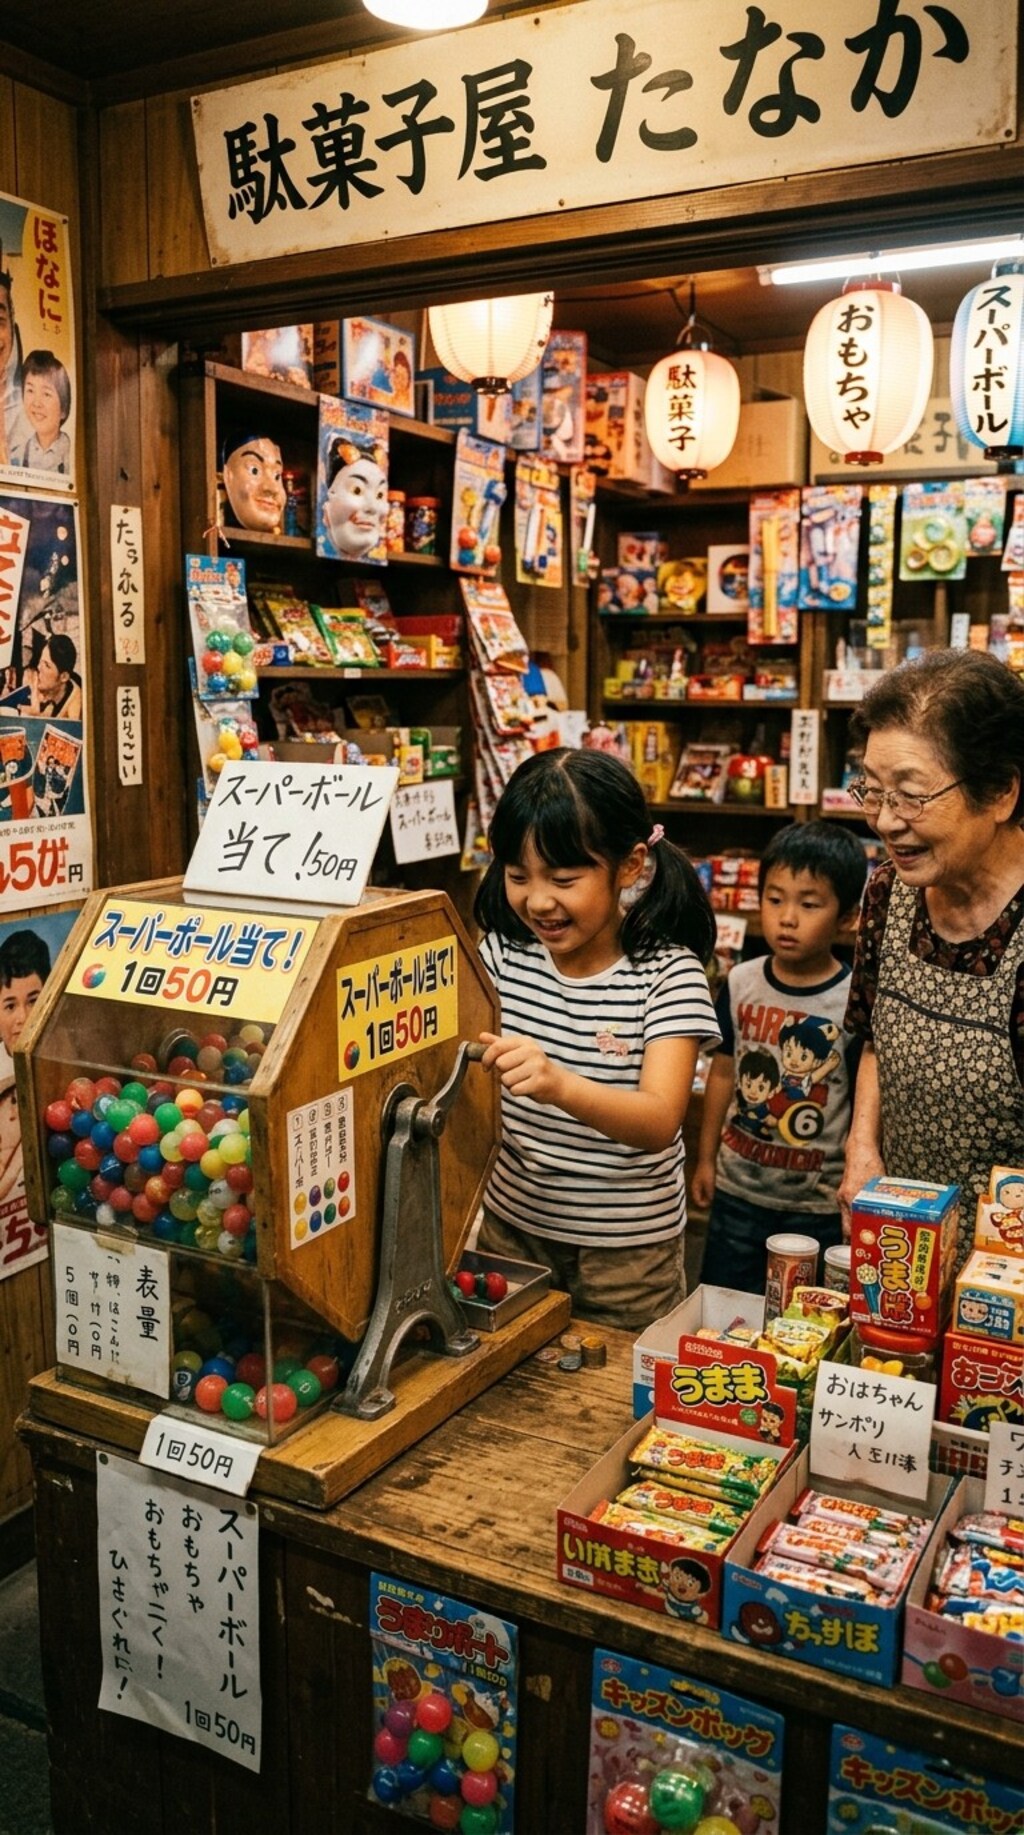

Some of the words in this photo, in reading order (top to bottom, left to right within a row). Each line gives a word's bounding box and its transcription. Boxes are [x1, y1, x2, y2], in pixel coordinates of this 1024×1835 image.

[226, 57, 547, 224] 駄菓子屋
[590, 0, 970, 163] たなか
[33, 215, 62, 322] ほなに
[836, 303, 875, 430] おもちゃ
[972, 283, 1012, 434] スーパーボール
[665, 365, 697, 452] 駄菓子
[218, 774, 383, 812] スーパーボール
[120, 960, 239, 1007] 1回50円
[366, 1005, 437, 1060] 1回50円
[794, 1108, 818, 1136] 6
[671, 1360, 770, 1406] うまま
[826, 1373, 923, 1412] おはちゃん
[818, 1408, 885, 1439] サンポリ
[155, 1432, 233, 1478] 1回50円
[182, 1504, 204, 1613] おもちゃ
[218, 1509, 247, 1699] スーパーボール
[185, 1700, 255, 1755] 1回50円
